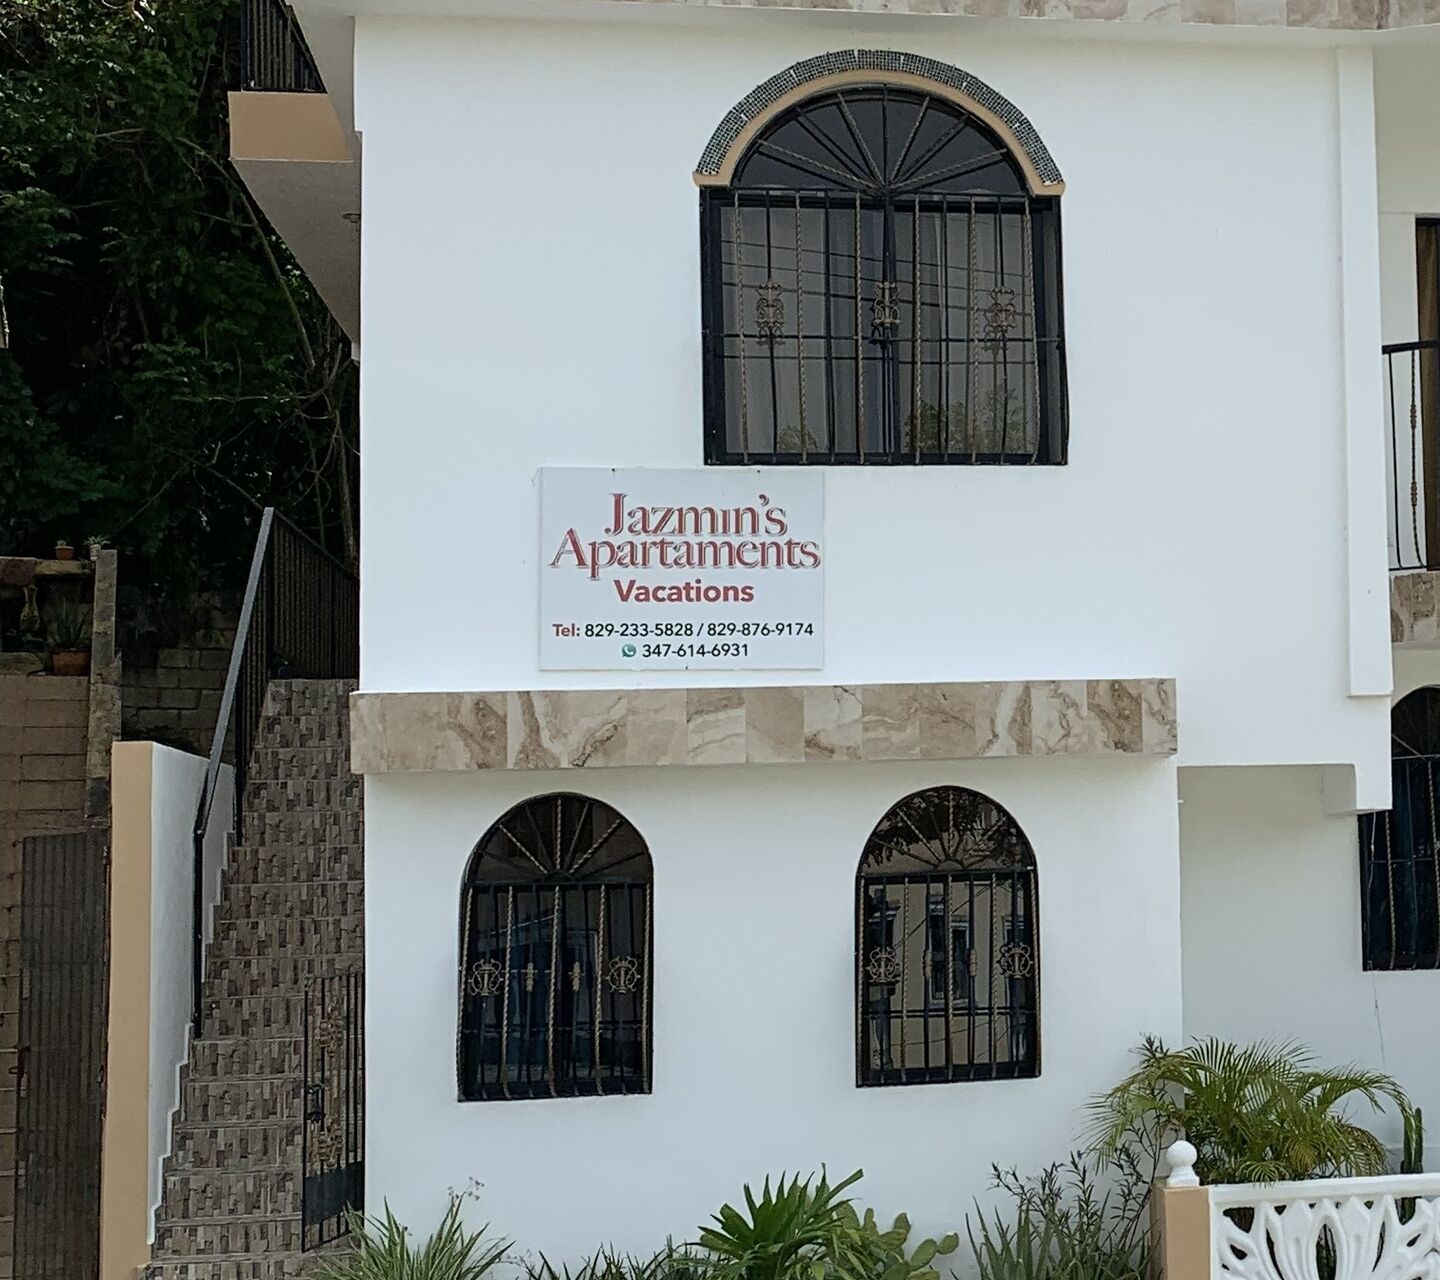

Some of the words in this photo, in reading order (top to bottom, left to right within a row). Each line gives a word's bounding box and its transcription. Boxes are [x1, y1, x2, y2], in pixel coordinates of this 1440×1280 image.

[548, 527, 821, 581] Apartaments
[613, 578, 755, 603] Vacations
[552, 623, 581, 637] Tel:
[585, 622, 694, 638] 829-233-5828
[697, 622, 705, 638] /
[707, 622, 814, 637] 829-876-9174
[642, 643, 749, 658] 347-614-6931
